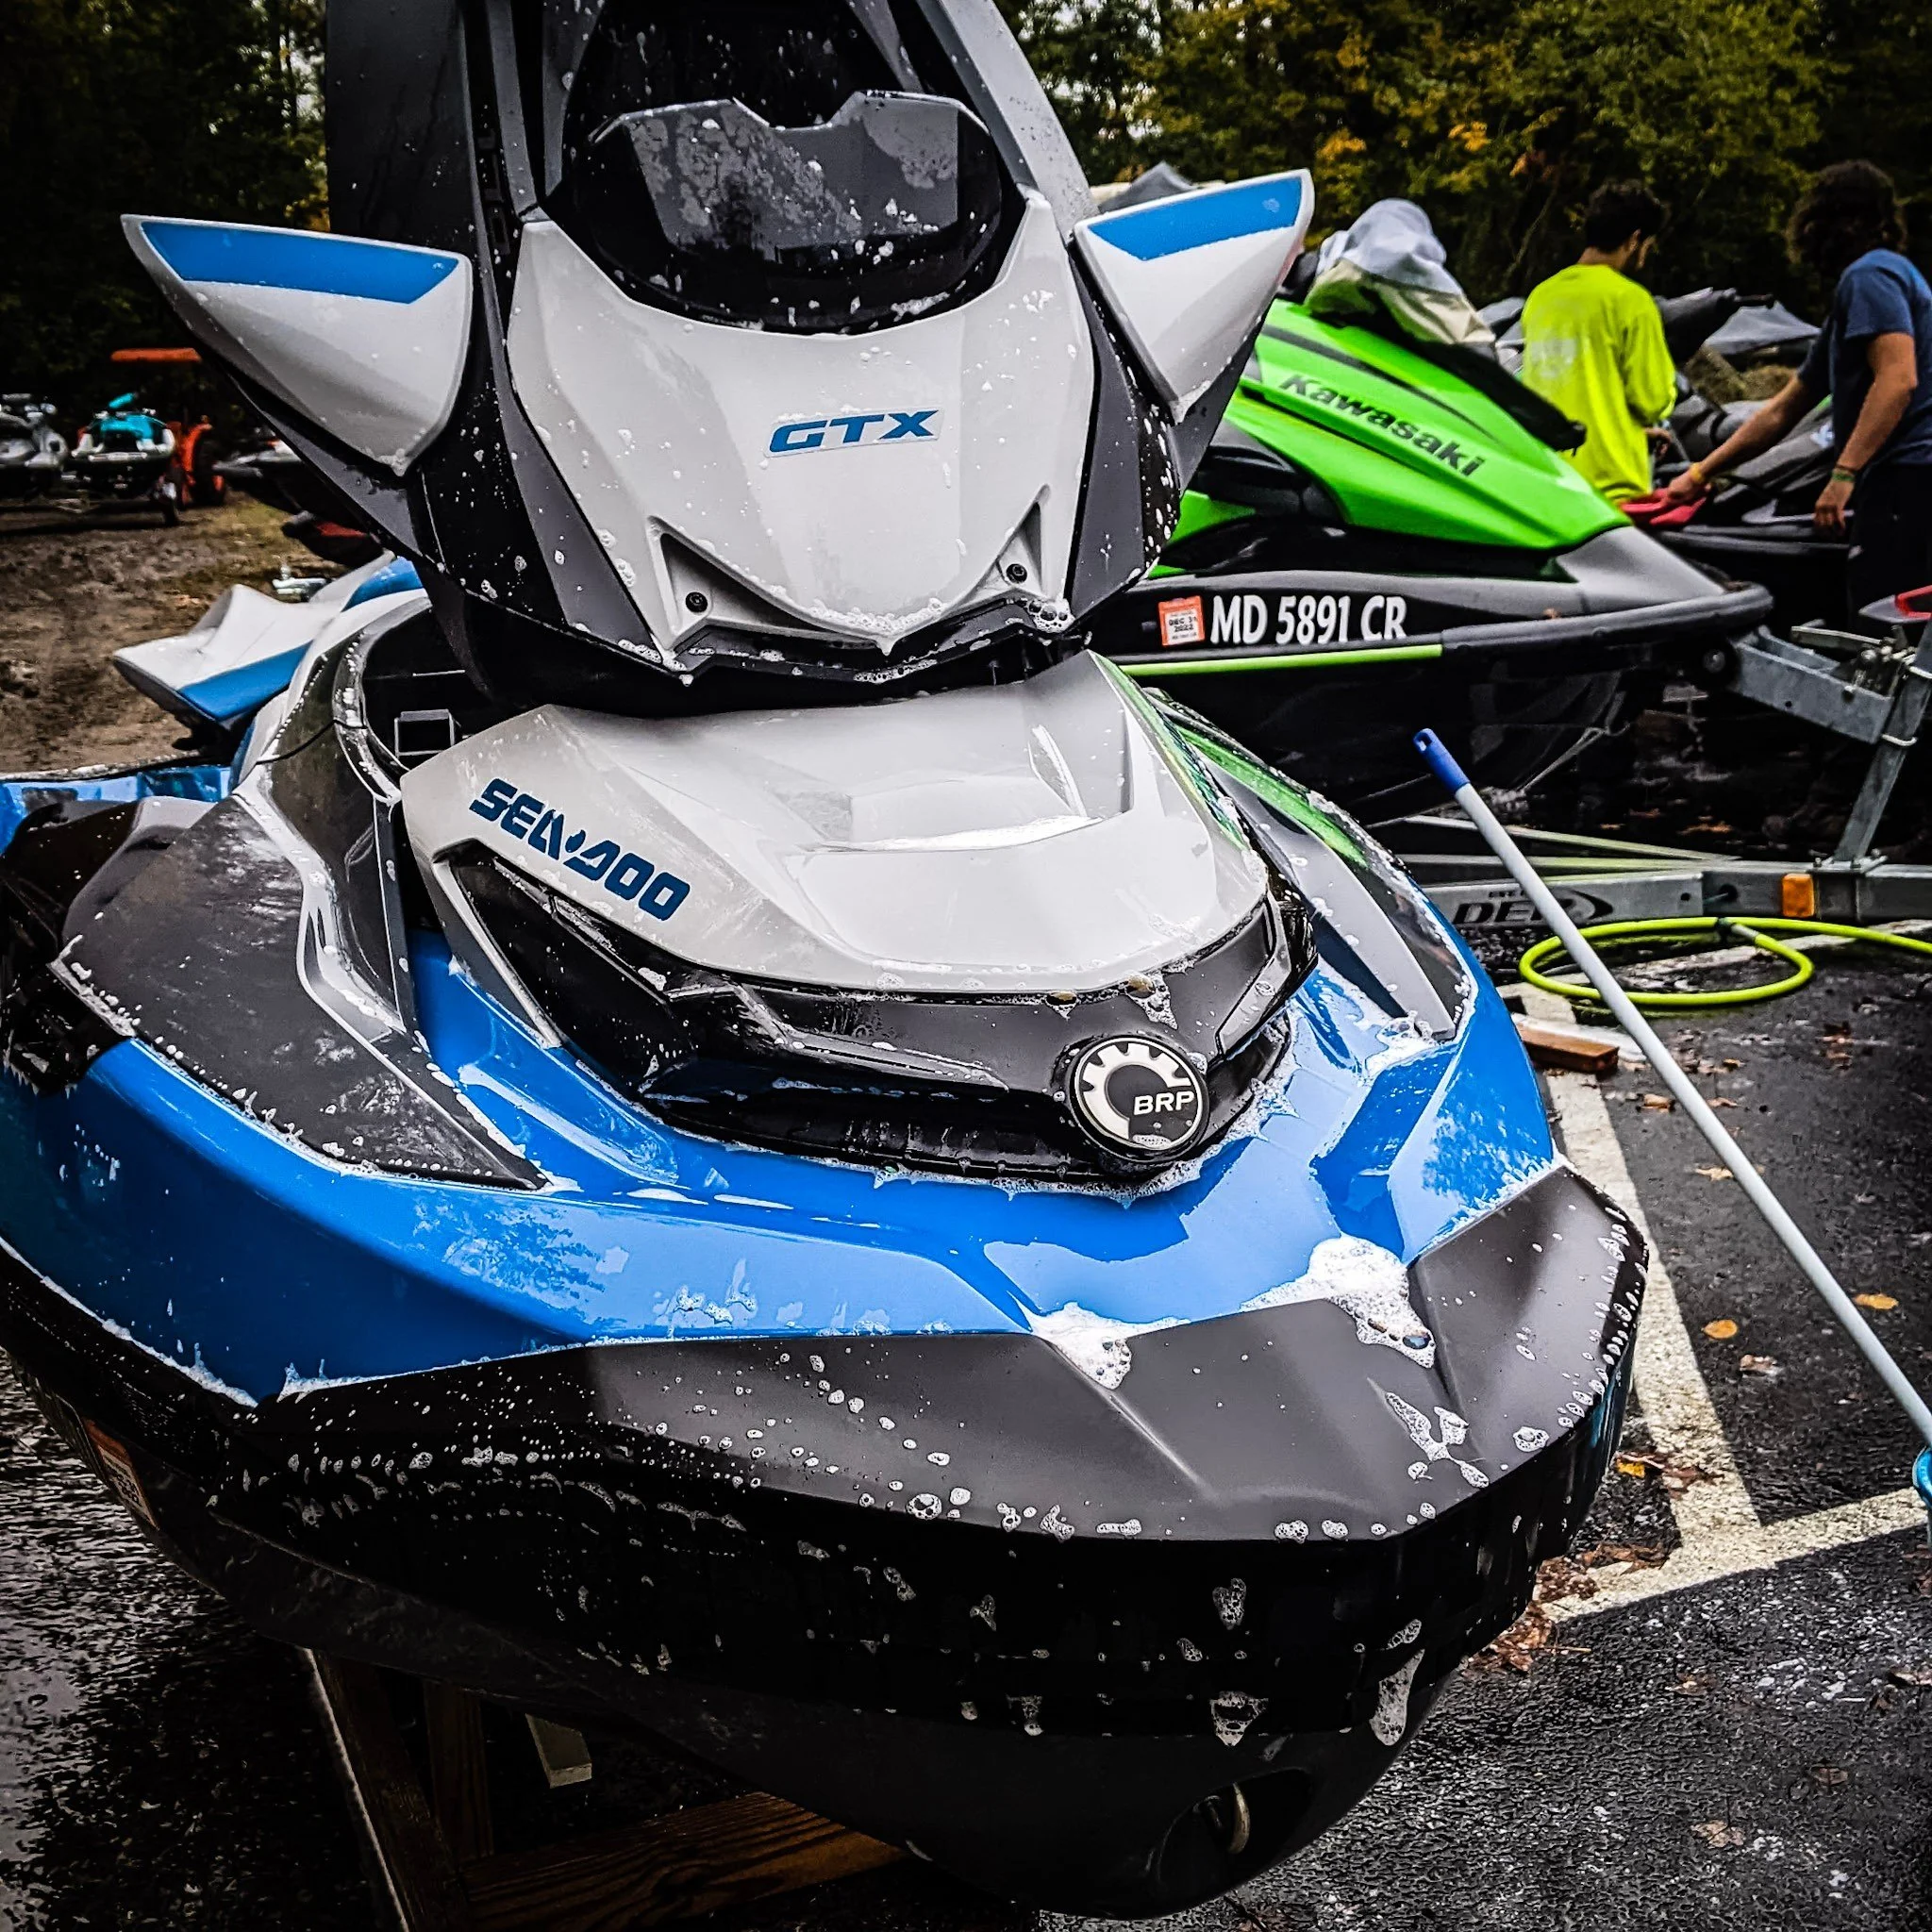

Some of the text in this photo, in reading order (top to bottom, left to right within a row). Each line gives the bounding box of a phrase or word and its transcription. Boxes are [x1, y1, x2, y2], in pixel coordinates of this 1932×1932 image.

[768, 408, 940, 454] GTX
[1278, 374, 1485, 476] Kawasaki
[1210, 594, 1407, 645] MD 5891 CR
[1133, 1091, 1195, 1116] BRP
